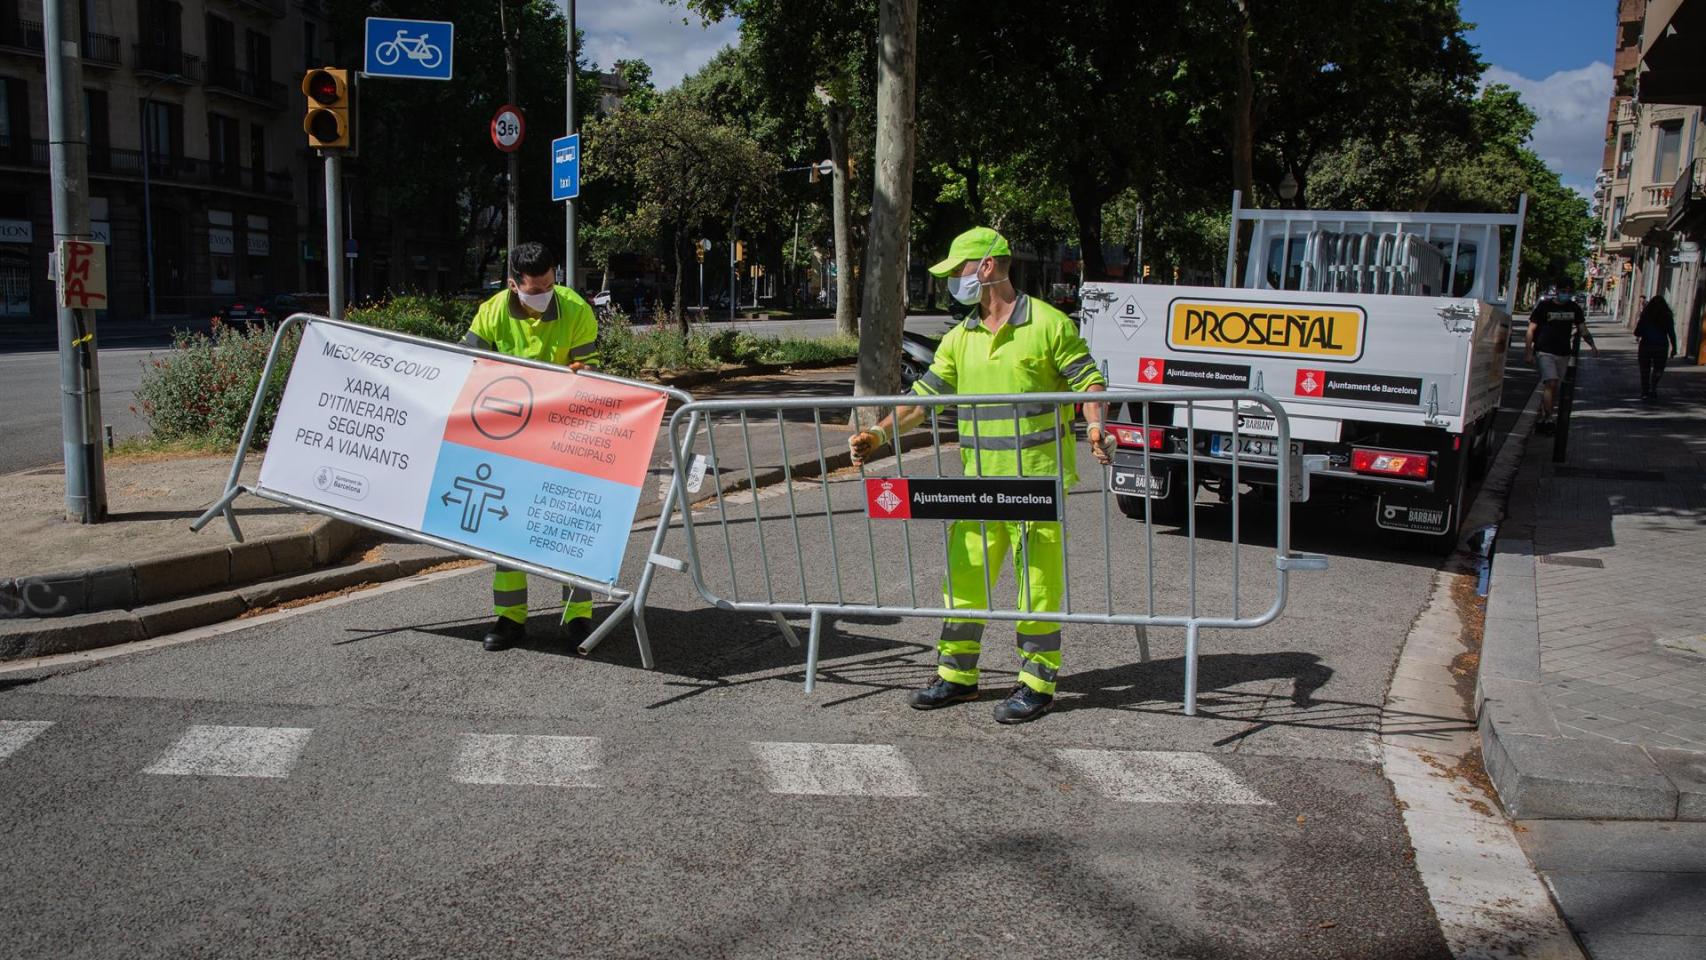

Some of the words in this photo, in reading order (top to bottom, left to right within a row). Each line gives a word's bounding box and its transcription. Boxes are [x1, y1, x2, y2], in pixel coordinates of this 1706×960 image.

[560, 176, 571, 189] taxi
[1126, 304, 1135, 315] B
[1184, 309, 1343, 350] PROSEÑAL
[322, 341, 394, 369] MESURES
[394, 360, 441, 381] COVID
[1166, 368, 1205, 379] Ajuntament
[1214, 372, 1247, 382] Barcelona
[343, 377, 390, 401] XARXA
[1327, 380, 1371, 391] Ajuntament
[1371, 384, 1381, 392] de
[1381, 385, 1418, 395] Barcelona
[318, 392, 408, 426] D'ITINERARIS
[574, 390, 624, 409] PROHIBIT
[548, 411, 597, 432] (EXCEPTE
[568, 403, 622, 422] CIRCULAR
[328, 415, 386, 442] SEGURS
[1245, 419, 1275, 431] BARBANY
[295, 428, 323, 448] PER
[323, 437, 334, 451] A
[338, 438, 409, 470] VIANANTS
[562, 430, 568, 439] I
[568, 431, 612, 449] SERVEIS
[1268, 441, 1299, 457] LR
[550, 440, 616, 465] MUNICIPALS)
[541, 481, 602, 505] RESPECTEU
[1135, 477, 1164, 490] BAANY
[533, 494, 547, 506] LA
[549, 498, 602, 519] DISTÀNCIA
[913, 491, 977, 504] Ajuntament
[979, 493, 994, 504] de
[996, 493, 1053, 505] Barcelona
[527, 506, 542, 519] DE
[543, 510, 603, 534] SEGURETAT
[1408, 510, 1444, 525] BARBANY
[526, 520, 541, 533] DE
[542, 524, 558, 537] 2M
[560, 529, 595, 547] ENTRE
[529, 535, 585, 559] PERSONES
